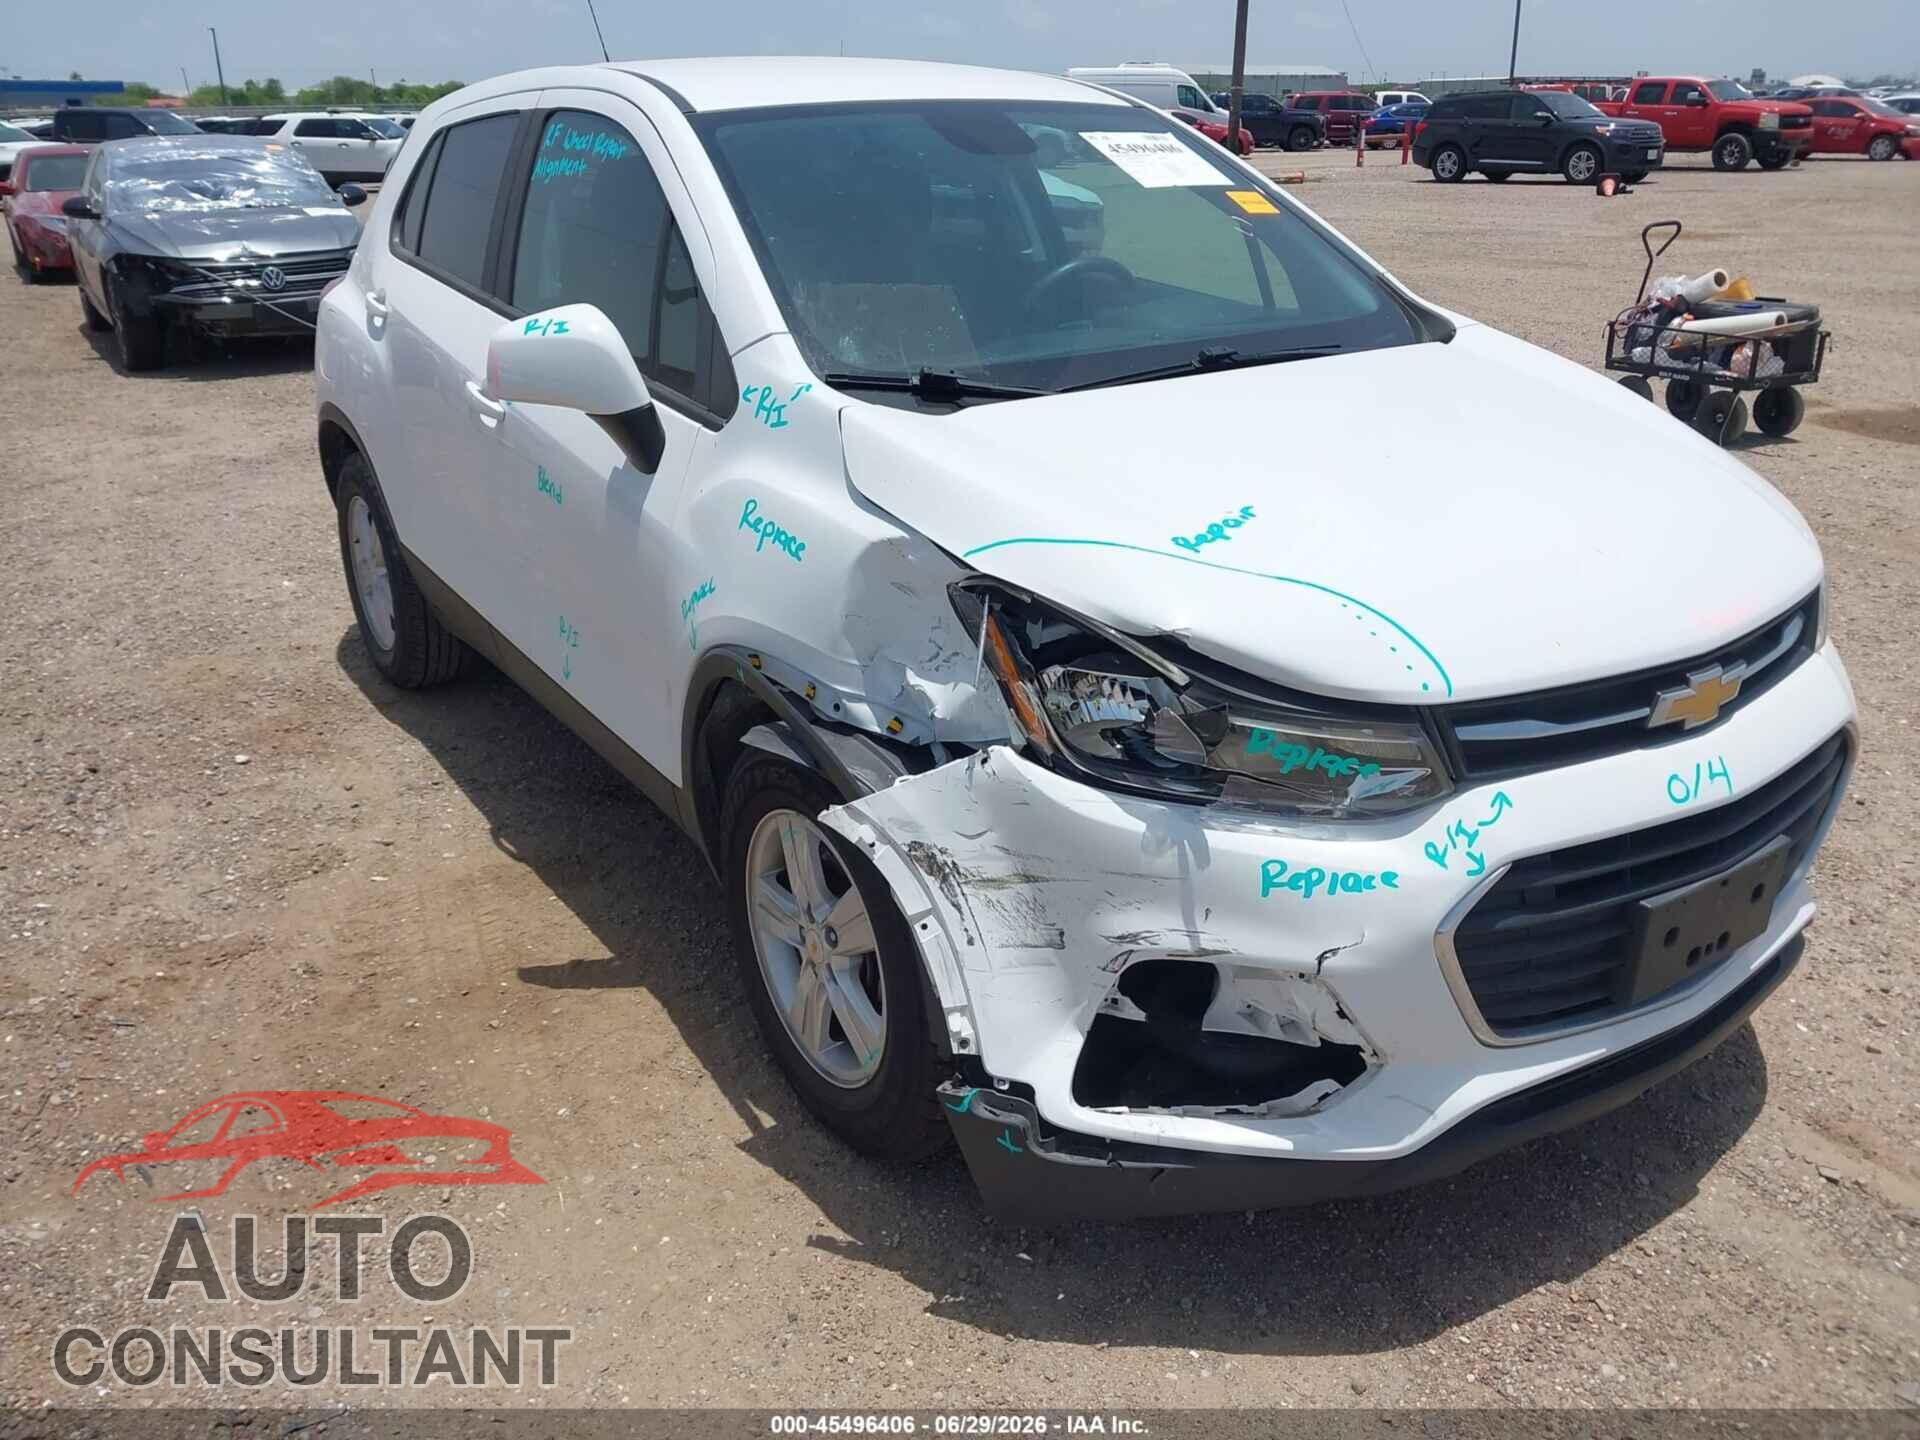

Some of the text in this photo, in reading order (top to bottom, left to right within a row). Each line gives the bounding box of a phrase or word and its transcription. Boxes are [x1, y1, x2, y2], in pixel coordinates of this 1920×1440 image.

[523, 318, 570, 336] R/I
[1247, 727, 1381, 780] Replace
[1424, 819, 1479, 870] R/I
[1261, 859, 1400, 898] Replace
